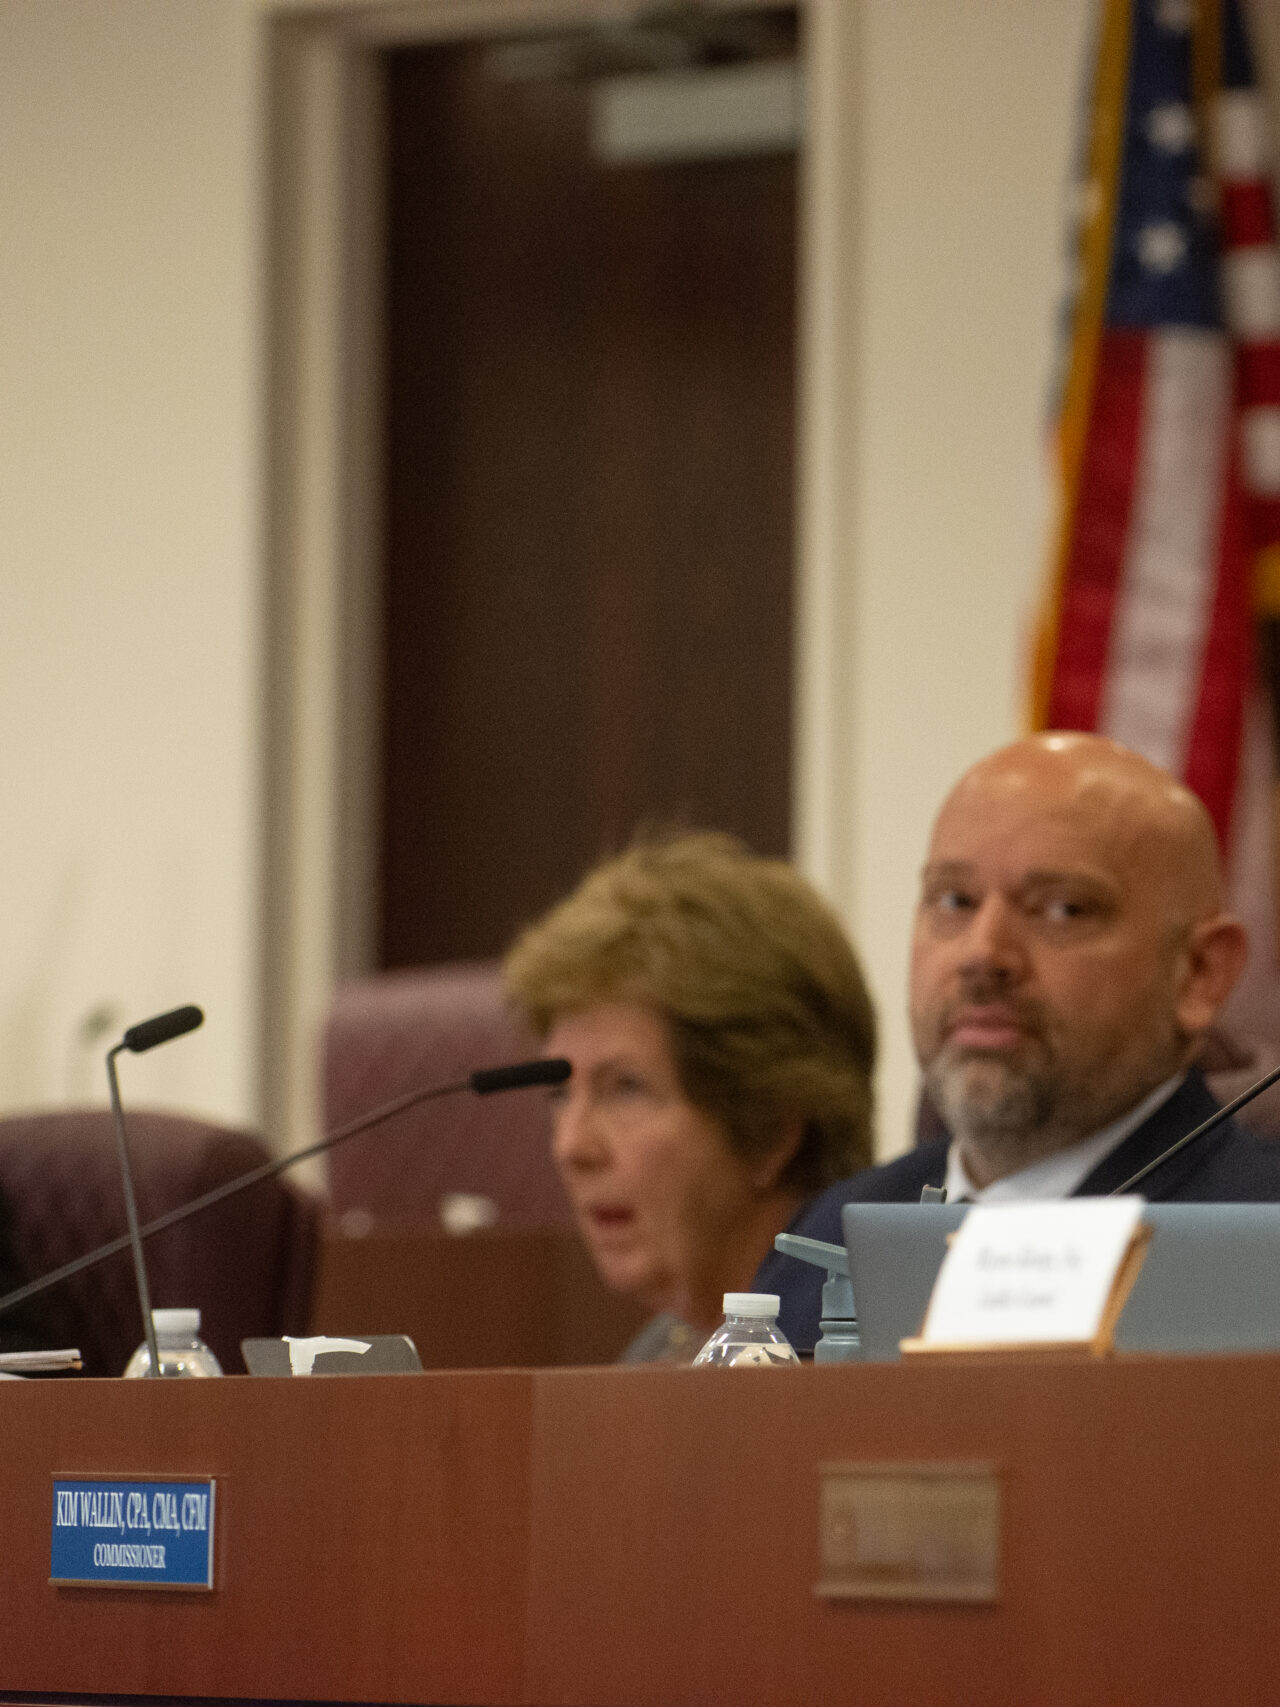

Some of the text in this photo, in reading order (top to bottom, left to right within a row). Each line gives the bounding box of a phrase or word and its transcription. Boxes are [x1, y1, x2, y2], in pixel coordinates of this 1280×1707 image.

[56, 1491, 208, 1538] KIM WALLIN, CPA, CMA, CFM
[93, 1543, 166, 1569] COMMISSIONER
